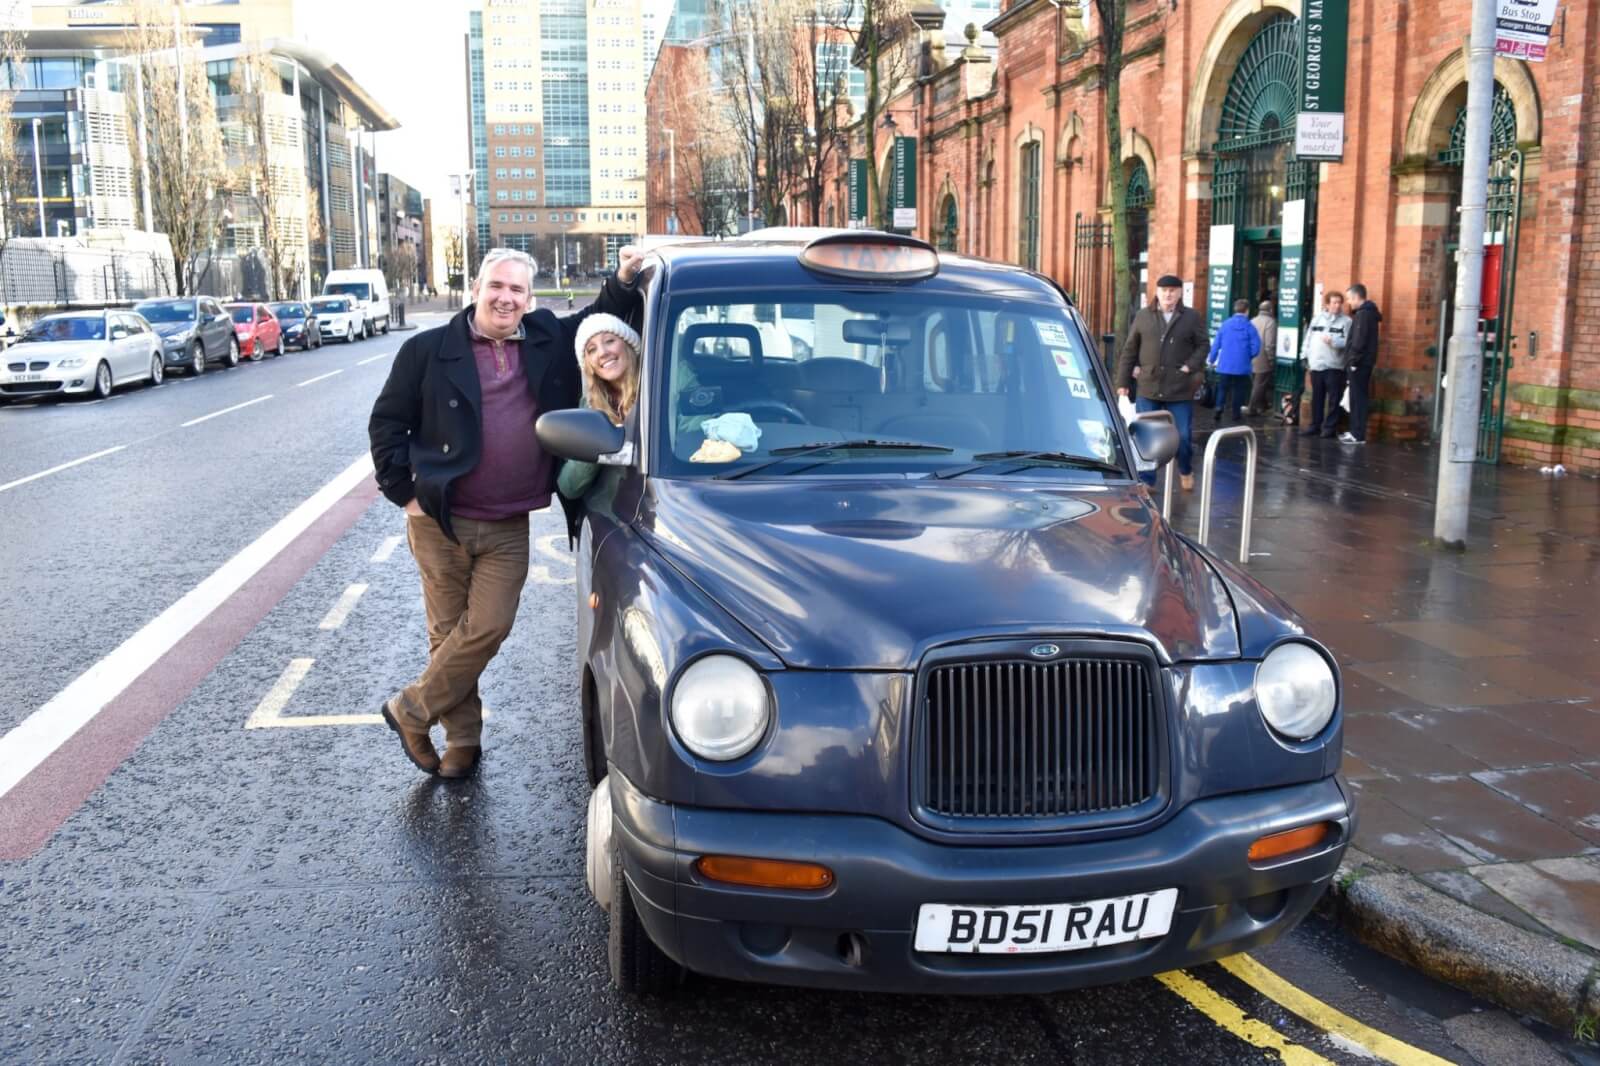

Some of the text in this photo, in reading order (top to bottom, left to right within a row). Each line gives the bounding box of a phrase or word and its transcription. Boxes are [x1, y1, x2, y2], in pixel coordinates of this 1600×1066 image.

[68, 8, 104, 19] Hilton
[1502, 6, 1541, 21] Bus Stop
[1525, 23, 1547, 33] Market
[1306, 23, 1322, 90] GEORGE'S
[1305, 93, 1319, 110] ST
[1311, 116, 1332, 128] Your
[1301, 128, 1339, 140] weekend
[1303, 141, 1336, 152] market
[836, 246, 912, 271] TAXI
[1073, 383, 1087, 394] AA
[947, 897, 1150, 944] BD51 RAU
